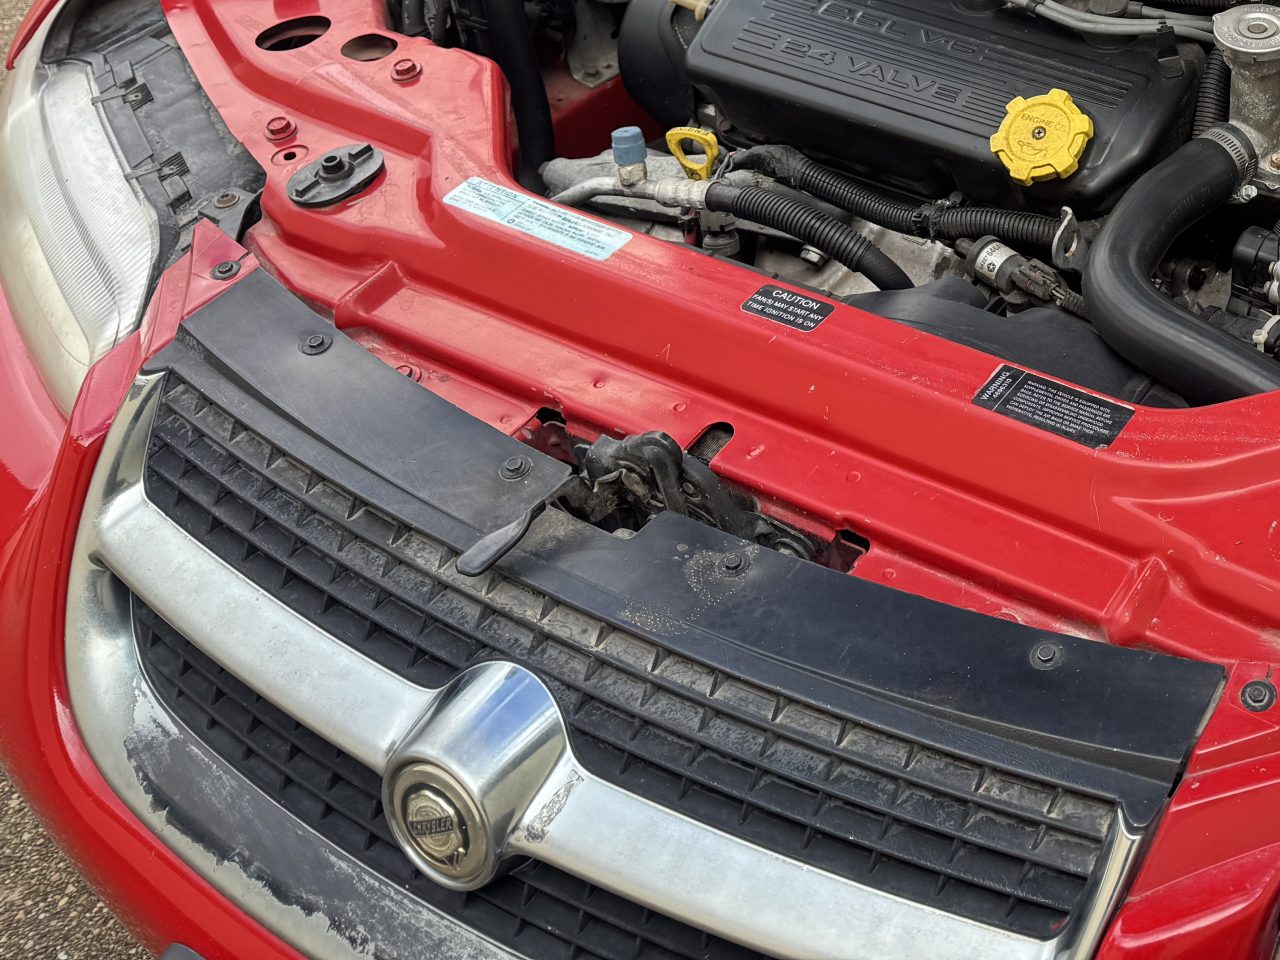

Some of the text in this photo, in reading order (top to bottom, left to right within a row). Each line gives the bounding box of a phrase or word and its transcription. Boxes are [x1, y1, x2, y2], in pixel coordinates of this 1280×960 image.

[780, 38, 962, 103] 24 VALVE
[752, 294, 824, 321] FAN(S) MAY START ANY
[772, 289, 820, 310] CAUTION
[747, 301, 764, 311] TIME
[764, 307, 795, 322] IGNITION
[803, 320, 816, 328] ON
[980, 371, 1010, 400] WARNING
